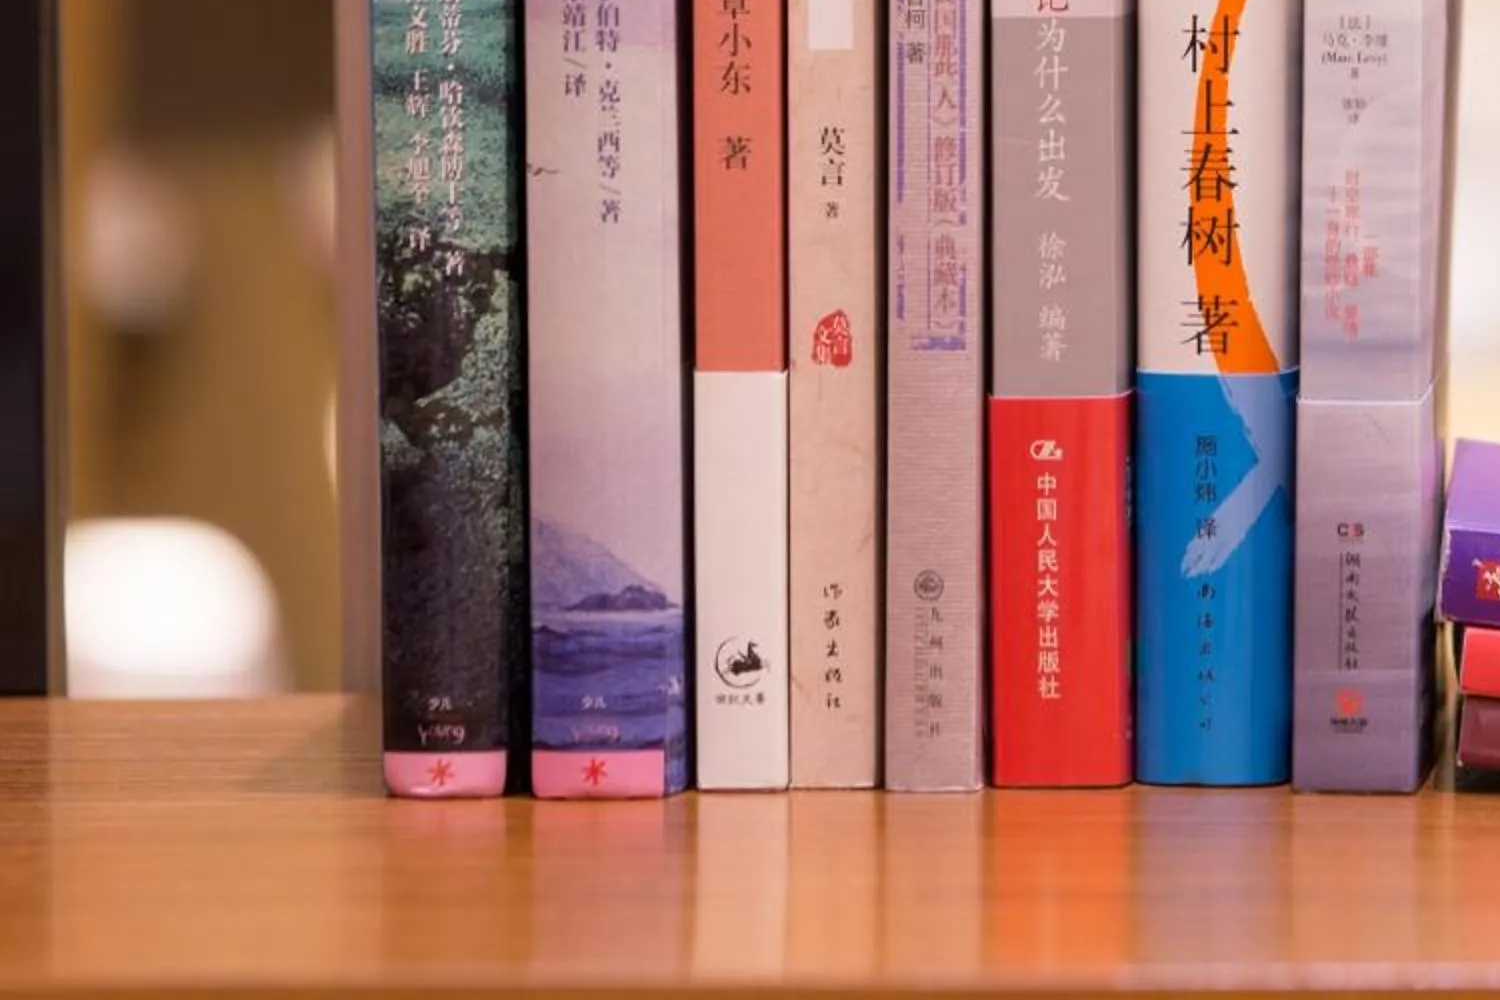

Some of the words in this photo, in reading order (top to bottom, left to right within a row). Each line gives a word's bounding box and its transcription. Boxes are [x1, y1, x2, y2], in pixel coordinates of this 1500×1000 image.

[718, 134, 753, 171] 著
[819, 126, 846, 188] 莫言
[1179, 13, 1241, 268] 村上春树
[825, 201, 840, 220] 著
[1037, 230, 1068, 291] 徐泓
[1037, 304, 1068, 363] 编著
[1179, 294, 1241, 356] 著
[1036, 471, 1061, 700] 中国人民大学出版社
